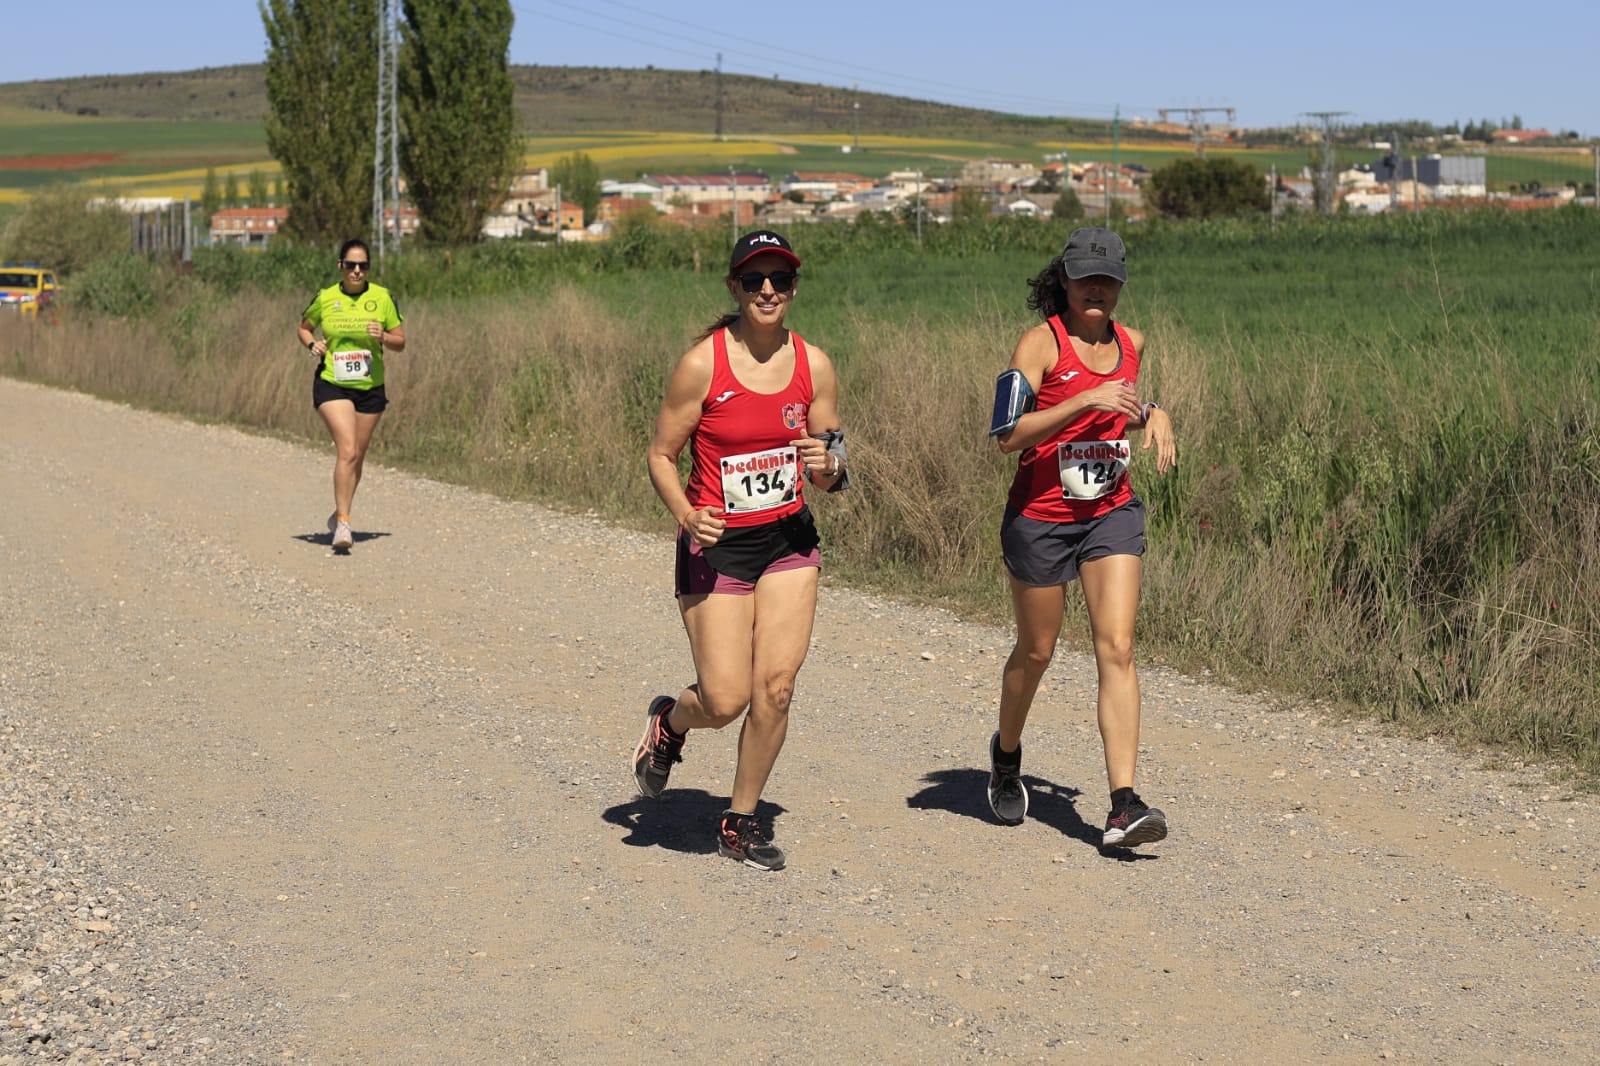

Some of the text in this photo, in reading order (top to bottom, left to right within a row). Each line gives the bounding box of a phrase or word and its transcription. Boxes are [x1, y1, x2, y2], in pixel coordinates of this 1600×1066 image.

[749, 234, 781, 246] FILA
[345, 361, 361, 373] 58
[741, 469, 785, 497] 134
